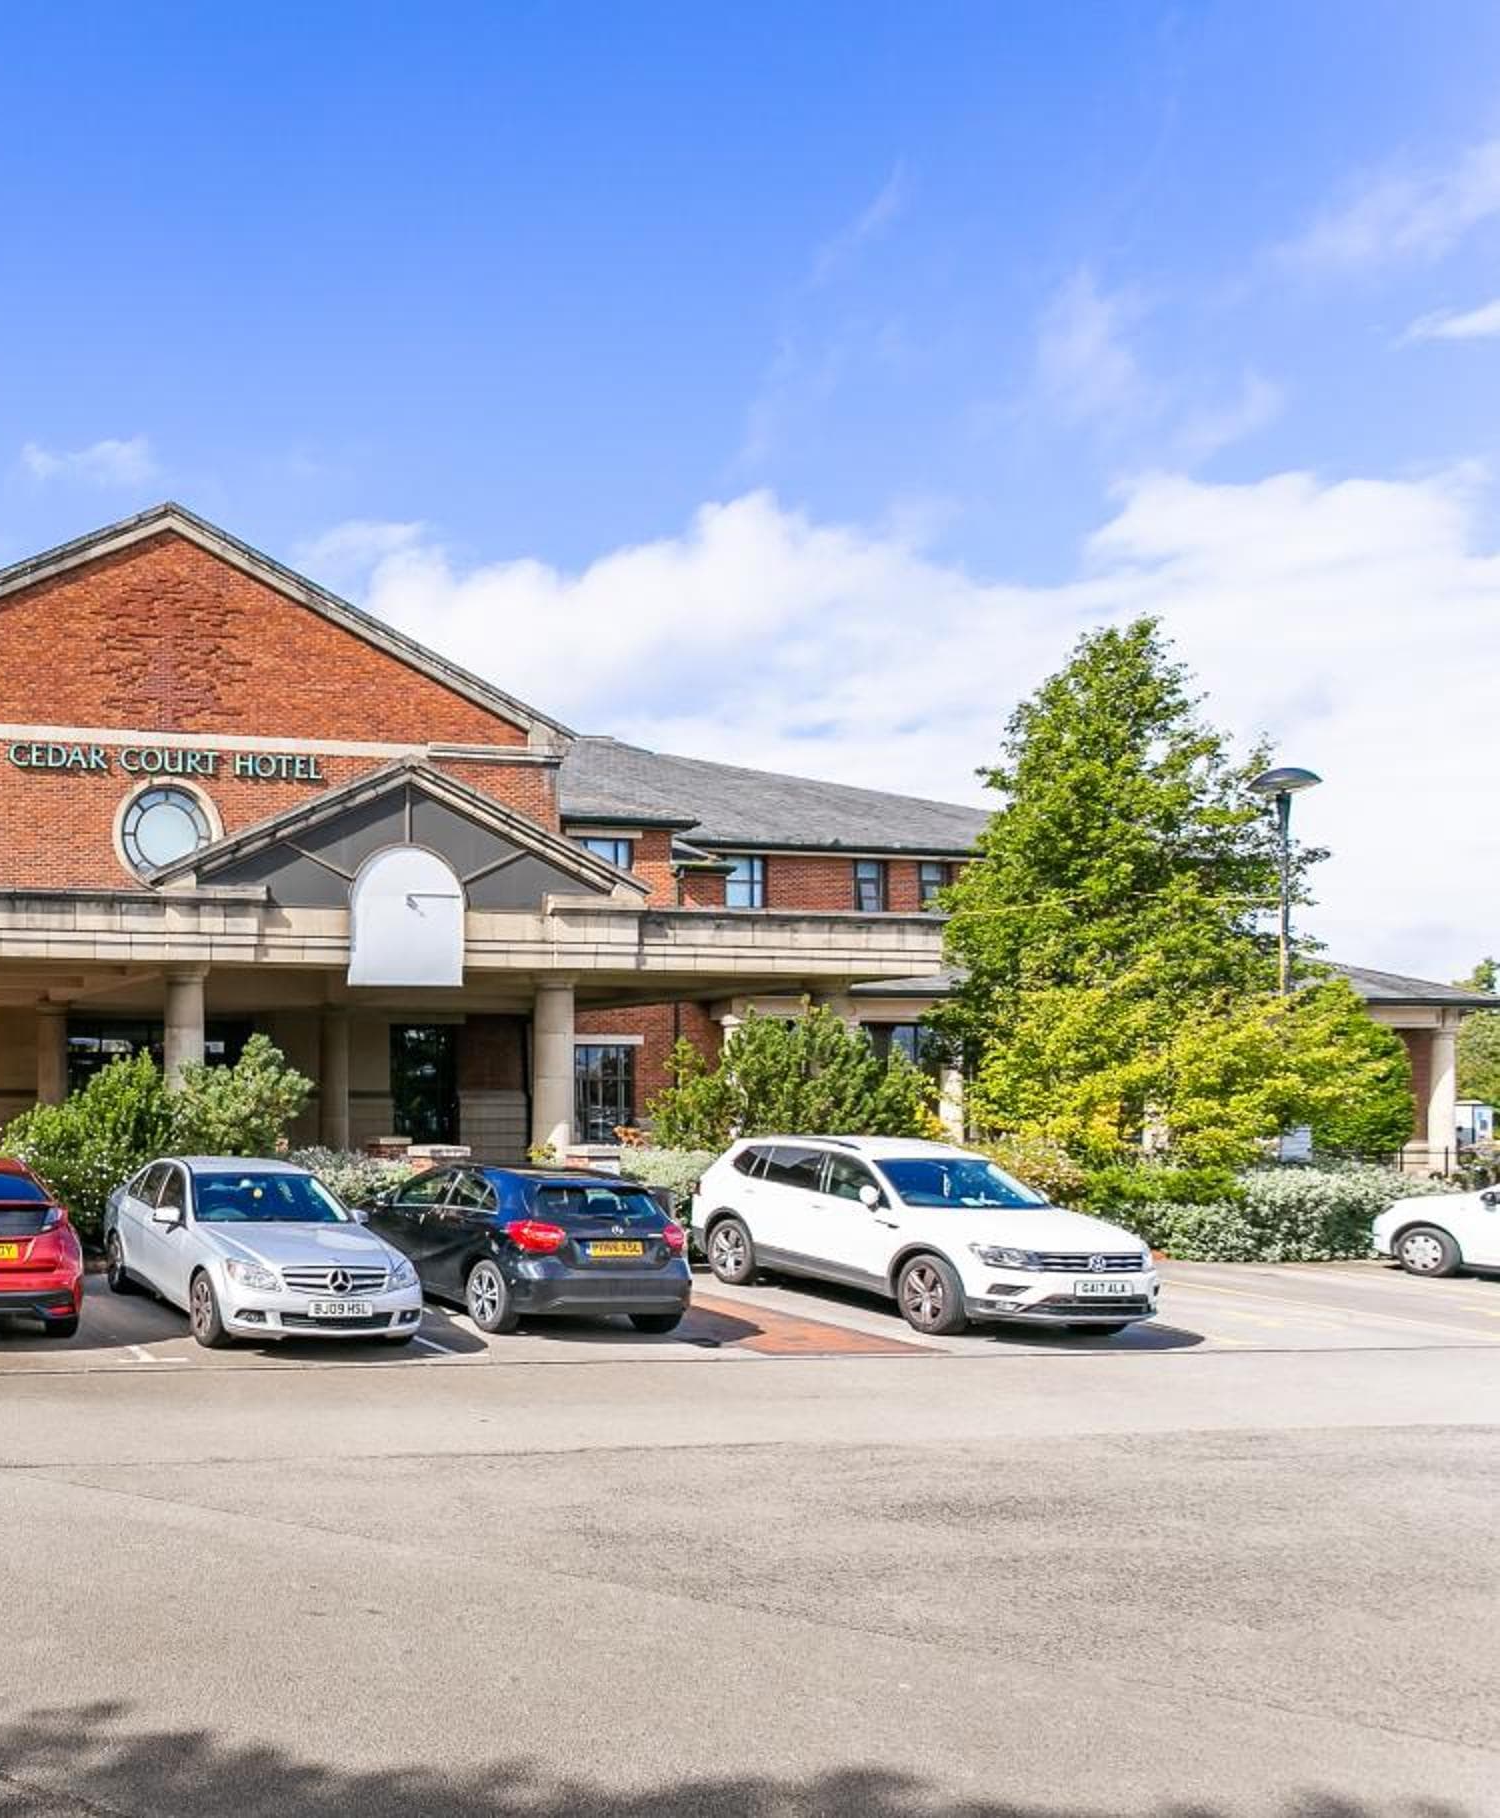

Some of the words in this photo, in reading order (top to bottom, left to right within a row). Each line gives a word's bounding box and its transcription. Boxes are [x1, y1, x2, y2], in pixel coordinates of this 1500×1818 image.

[8, 743, 107, 770] CEDAR
[120, 748, 220, 775] COURT
[234, 753, 323, 780] HOTEL
[314, 1303, 345, 1315] BJ09
[347, 1303, 368, 1315] HSL
